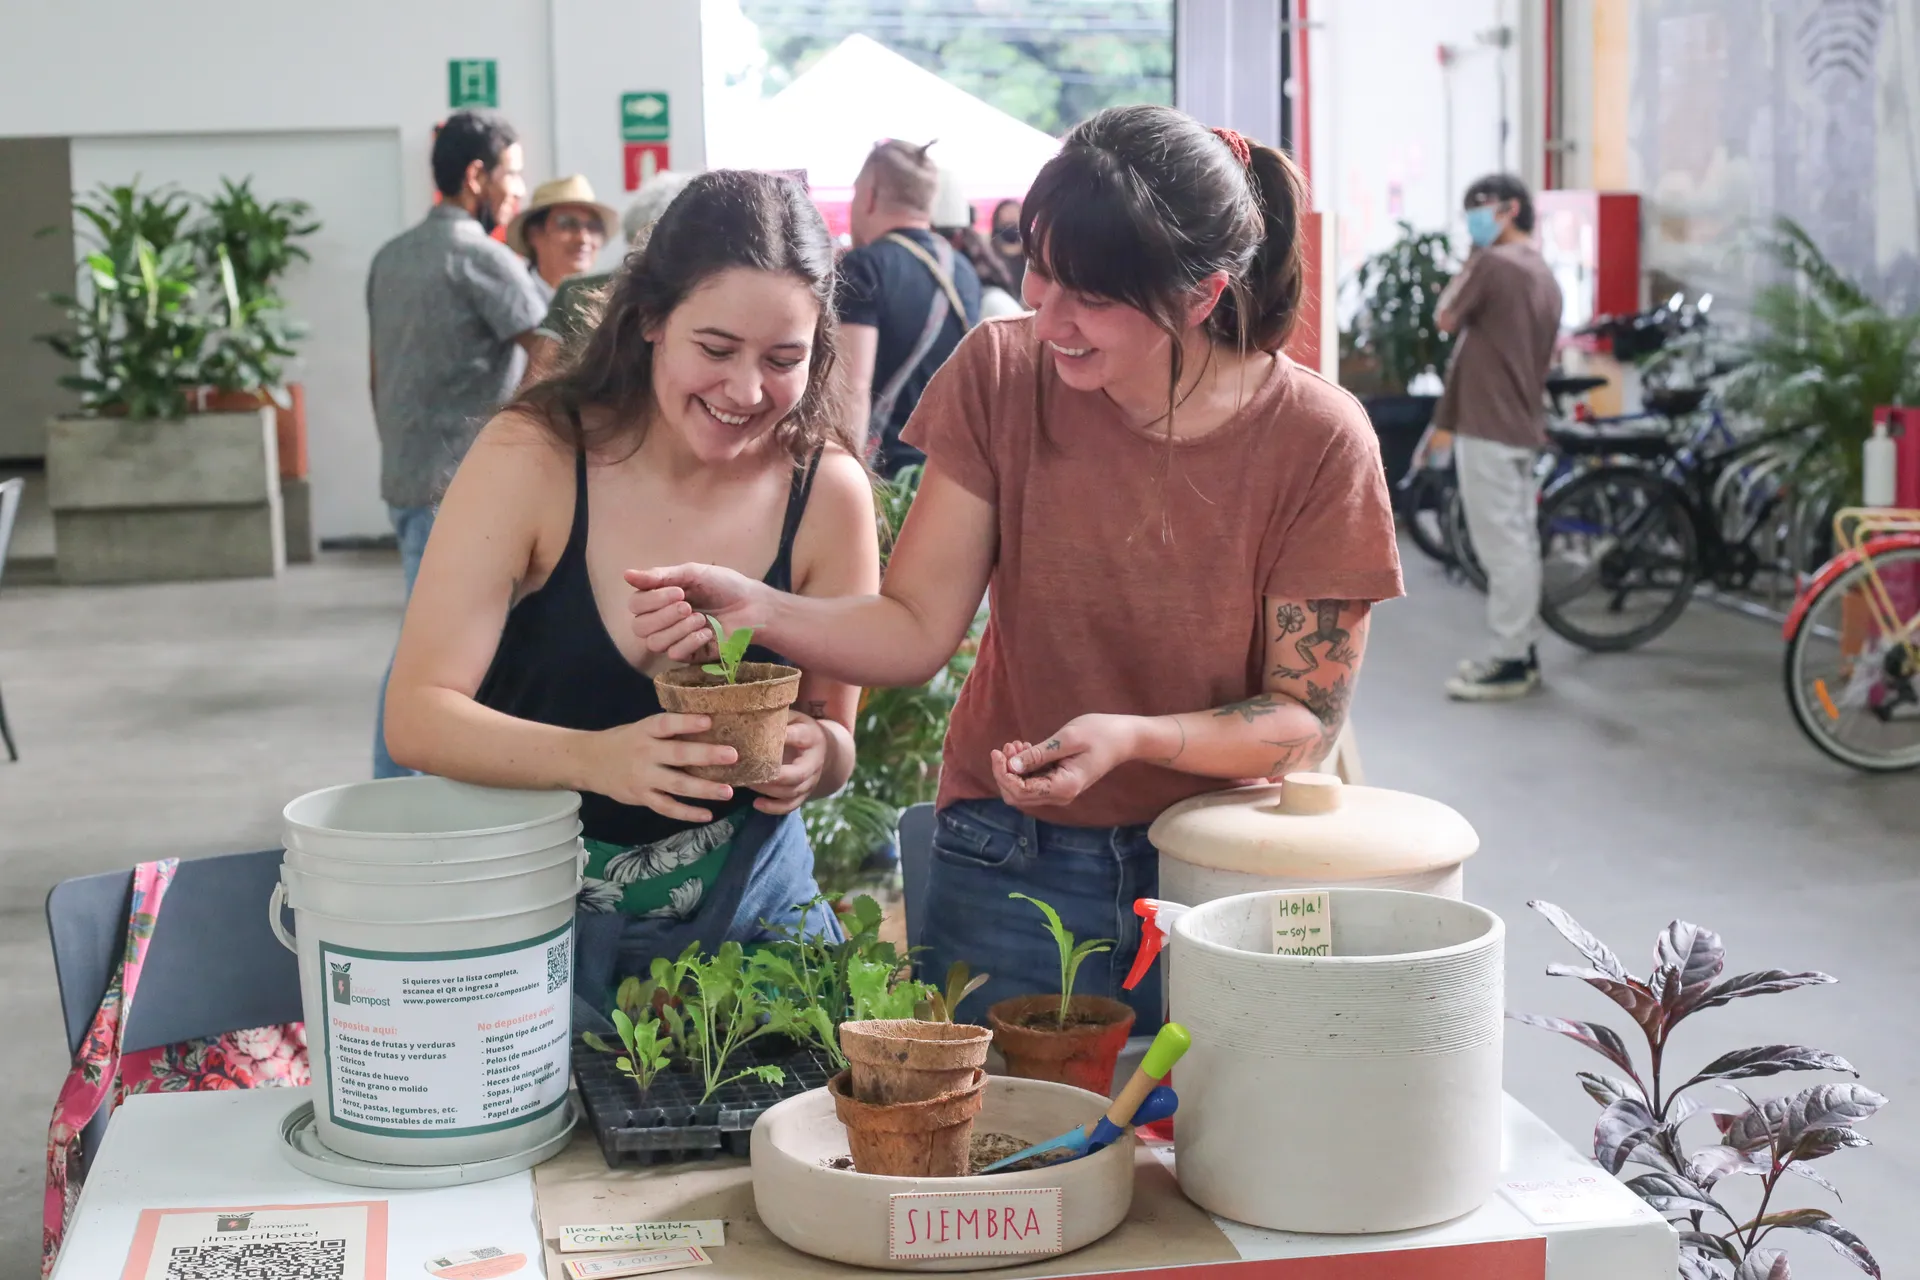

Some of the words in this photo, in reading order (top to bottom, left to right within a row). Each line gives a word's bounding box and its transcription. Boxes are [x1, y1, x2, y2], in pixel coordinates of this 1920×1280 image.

[1280, 896, 1320, 917] Hola!
[411, 978, 440, 986] quieres
[465, 984, 492, 992] ingresa
[352, 995, 390, 1007] compost
[402, 982, 540, 1005] www.powercompost.co/compostables
[333, 1018, 370, 1032] Deposita
[478, 1022, 492, 1031] No
[494, 1012, 536, 1028] deposites
[486, 1033, 514, 1043] Ningún
[515, 1029, 529, 1038] tipo
[539, 1019, 554, 1029] carne
[339, 1033, 369, 1046] Cáscaras
[382, 1041, 407, 1049] frutas
[340, 1044, 362, 1055] Restos
[374, 1051, 398, 1059] frutas
[486, 1044, 514, 1054] Huesos
[486, 1056, 507, 1065] Pelos
[509, 1053, 520, 1062] (de
[522, 1044, 547, 1057] mascota
[341, 1066, 370, 1078] Cáscaras
[383, 1073, 409, 1081] huevo
[486, 1064, 520, 1076] Plásticos
[487, 1077, 510, 1086] Heces
[522, 1066, 543, 1078] ningún
[544, 1062, 554, 1070] tipo
[341, 1077, 355, 1085] Café
[342, 1087, 378, 1100] Servilletas
[487, 1088, 511, 1097] Sopas,
[513, 1082, 533, 1093] jugos,
[342, 1098, 362, 1109] Arroz,
[364, 1103, 391, 1113] pastas,
[392, 1106, 440, 1115] legumbres,
[483, 1097, 512, 1110] general
[488, 1109, 509, 1118] Papel
[521, 1100, 540, 1110] cocina
[343, 1108, 364, 1119] Bolsas
[365, 1114, 420, 1125] compostables
[905, 1207, 1040, 1244] SIEMBRA
